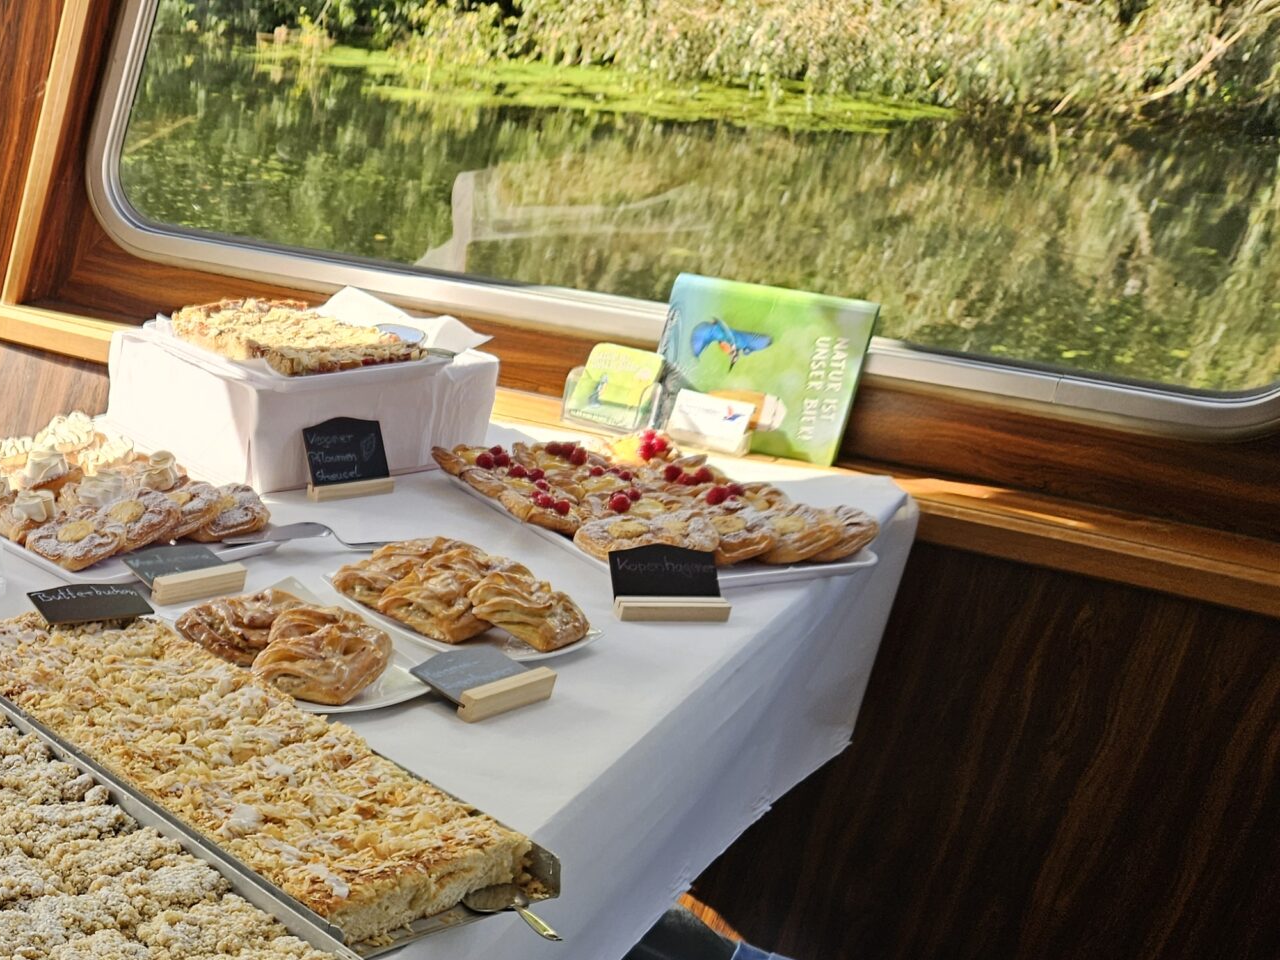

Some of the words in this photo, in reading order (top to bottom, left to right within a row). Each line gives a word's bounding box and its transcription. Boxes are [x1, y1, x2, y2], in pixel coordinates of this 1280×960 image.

[806, 336, 832, 391] UNSER
[824, 337, 850, 392] NATUR
[821, 398, 838, 422] IST
